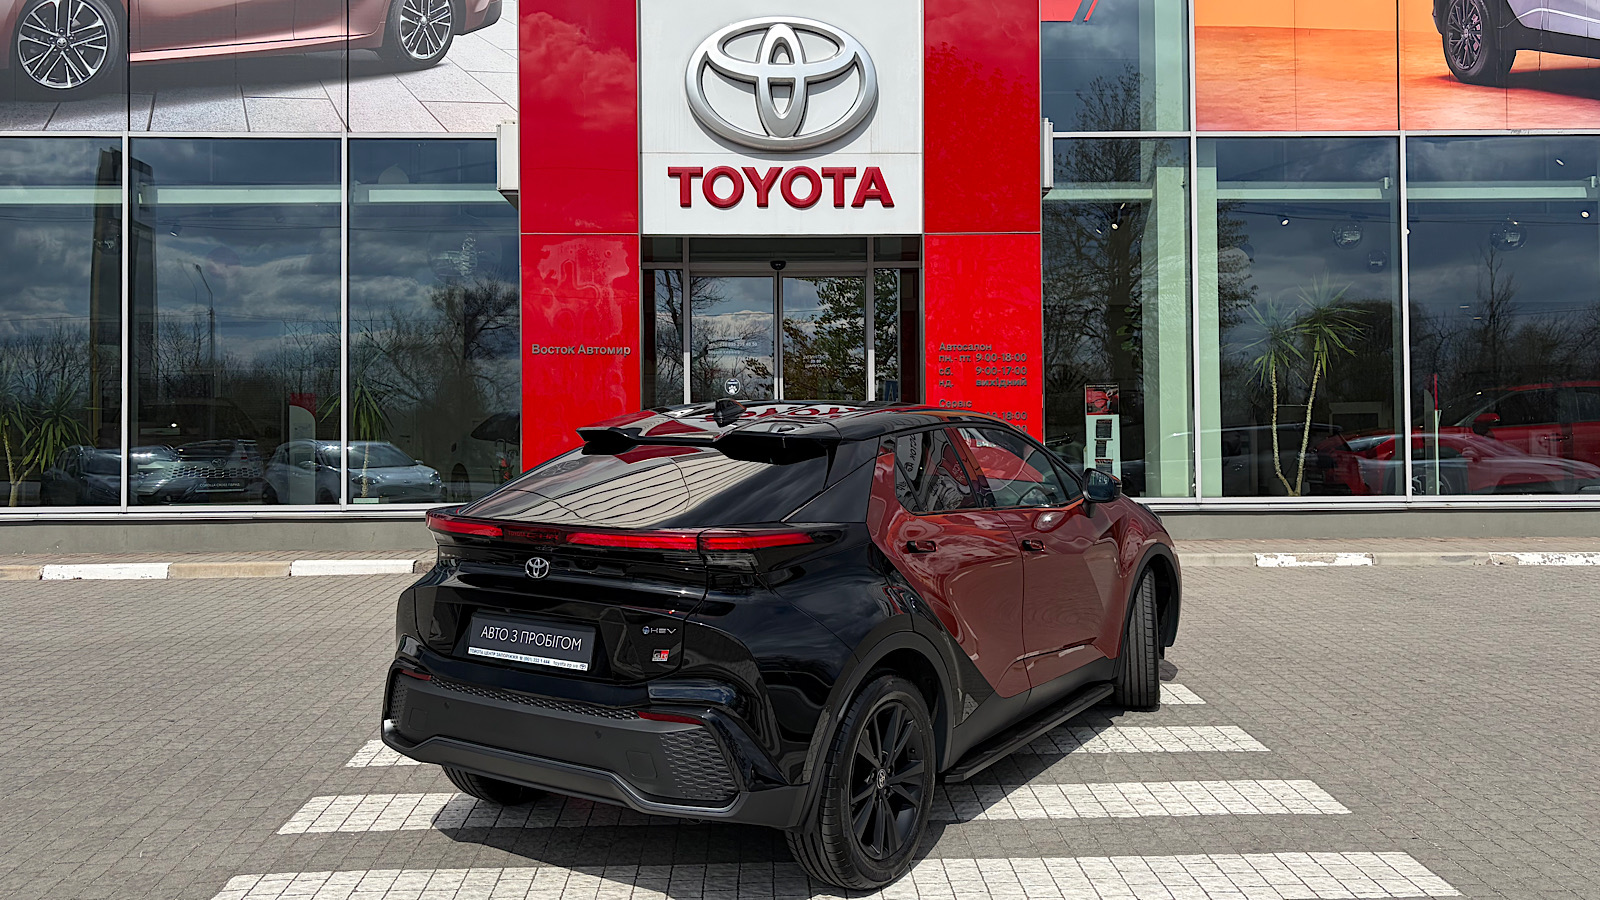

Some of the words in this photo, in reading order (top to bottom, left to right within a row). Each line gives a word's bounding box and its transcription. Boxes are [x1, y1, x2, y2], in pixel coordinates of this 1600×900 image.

[668, 166, 895, 210] TOYOTA
[531, 344, 575, 355] Восток
[577, 344, 631, 358] Автомир
[939, 342, 992, 351] Автосалон
[975, 353, 1027, 362] 9:00-18:00
[938, 366, 954, 376] сб.
[975, 366, 1027, 375] 9:00-17:00
[938, 379, 955, 388] нд.
[975, 377, 1027, 387] вихідний
[938, 399, 973, 408] Сервіс
[480, 625, 509, 642] АВТО
[510, 630, 518, 643] З
[519, 631, 583, 651] ПРОБІГОМ
